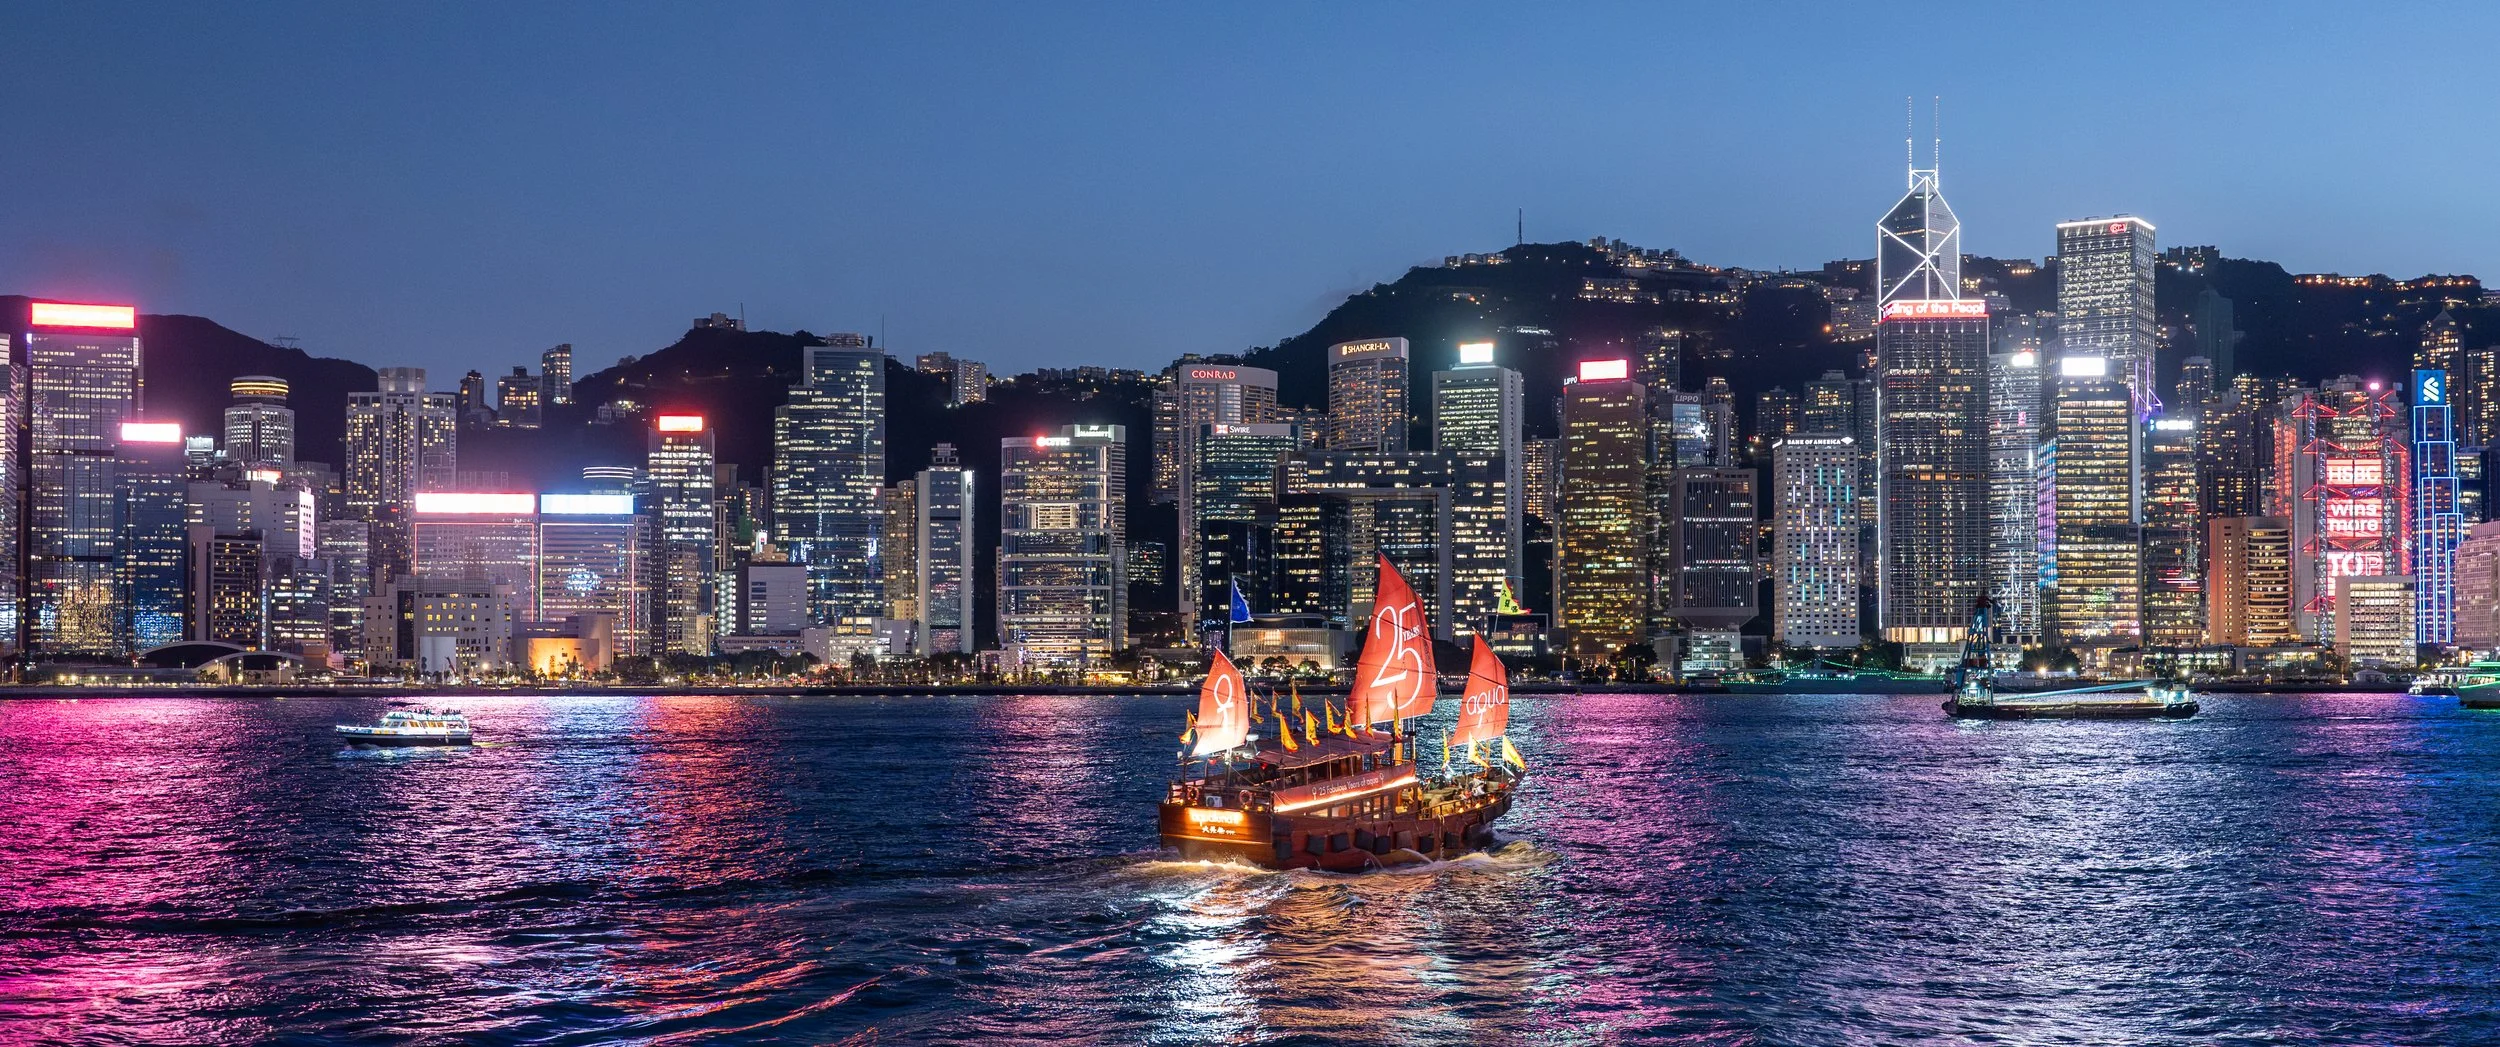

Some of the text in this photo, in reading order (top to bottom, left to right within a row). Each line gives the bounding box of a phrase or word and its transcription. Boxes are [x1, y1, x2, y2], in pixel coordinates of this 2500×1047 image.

[1916, 303, 1928, 314] of
[1931, 303, 1948, 313] the
[1348, 342, 1390, 353] SHANGRI-LA
[1192, 370, 1236, 380] CONRAD
[1563, 376, 1577, 386] LIPPO
[1675, 394, 1699, 402] LIPPO
[2328, 465, 2379, 481] HSBC
[2330, 500, 2377, 517] wins
[2328, 520, 2379, 532] more
[2326, 552, 2383, 577] TOP
[1370, 602, 1422, 710] 25
[1466, 684, 1505, 729] aqua
[1318, 786, 1326, 796] 25
[1347, 780, 1360, 789] Years
